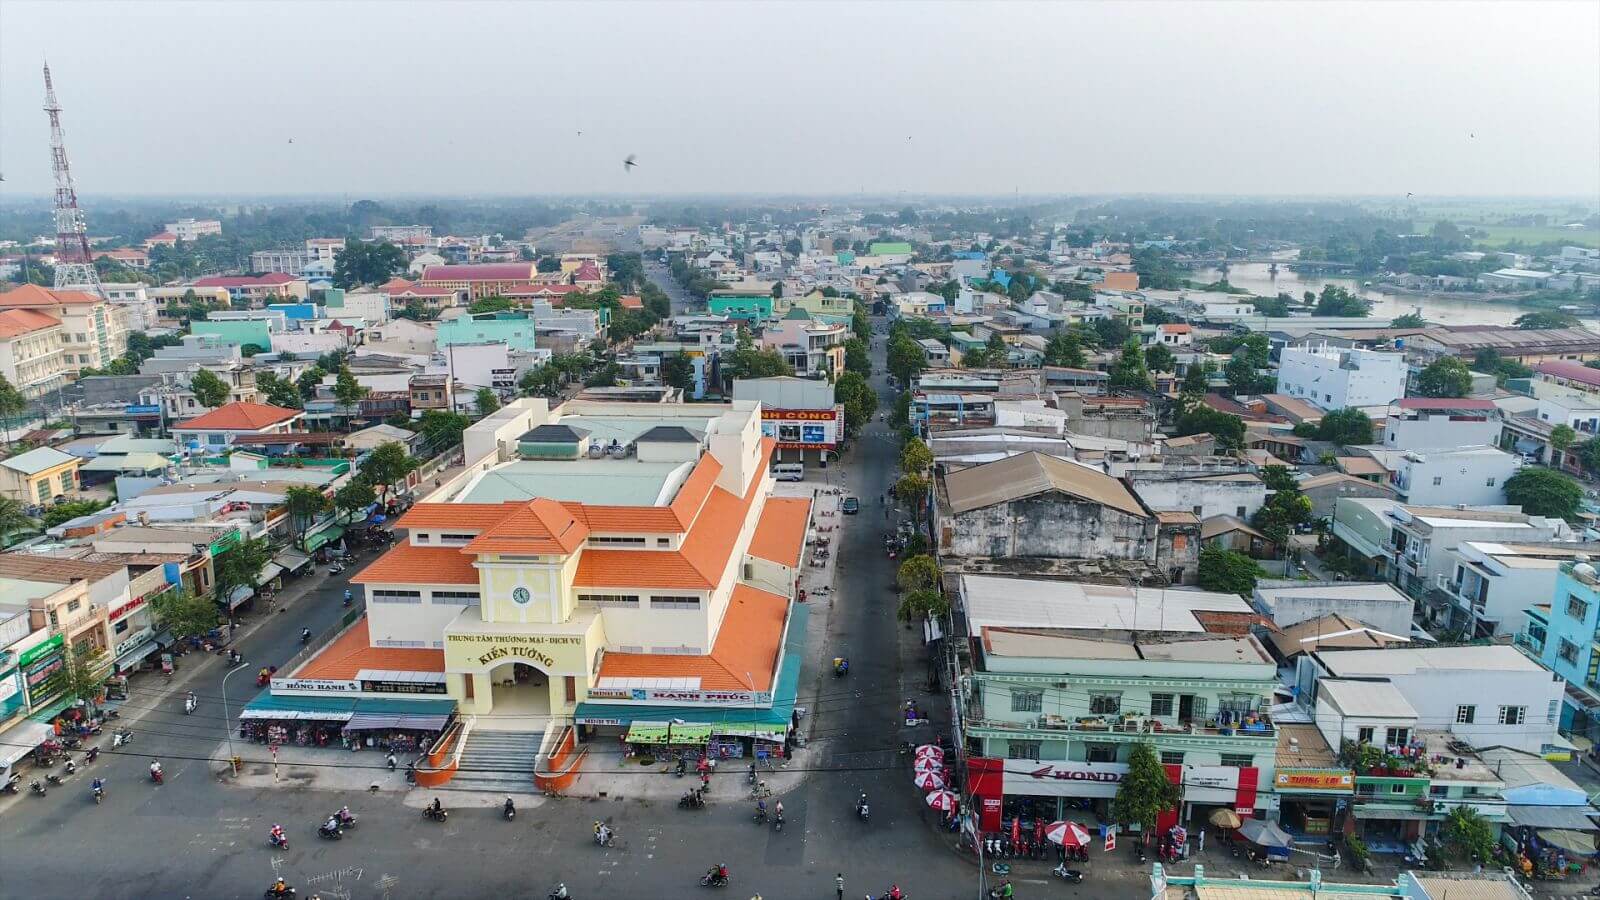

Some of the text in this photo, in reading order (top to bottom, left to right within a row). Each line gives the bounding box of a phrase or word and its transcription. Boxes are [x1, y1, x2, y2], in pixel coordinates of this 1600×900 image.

[448, 634, 475, 642] TRUNG
[477, 634, 493, 642] TÂM
[495, 634, 527, 643] THƯƠNG
[479, 645, 509, 665] KIẾN
